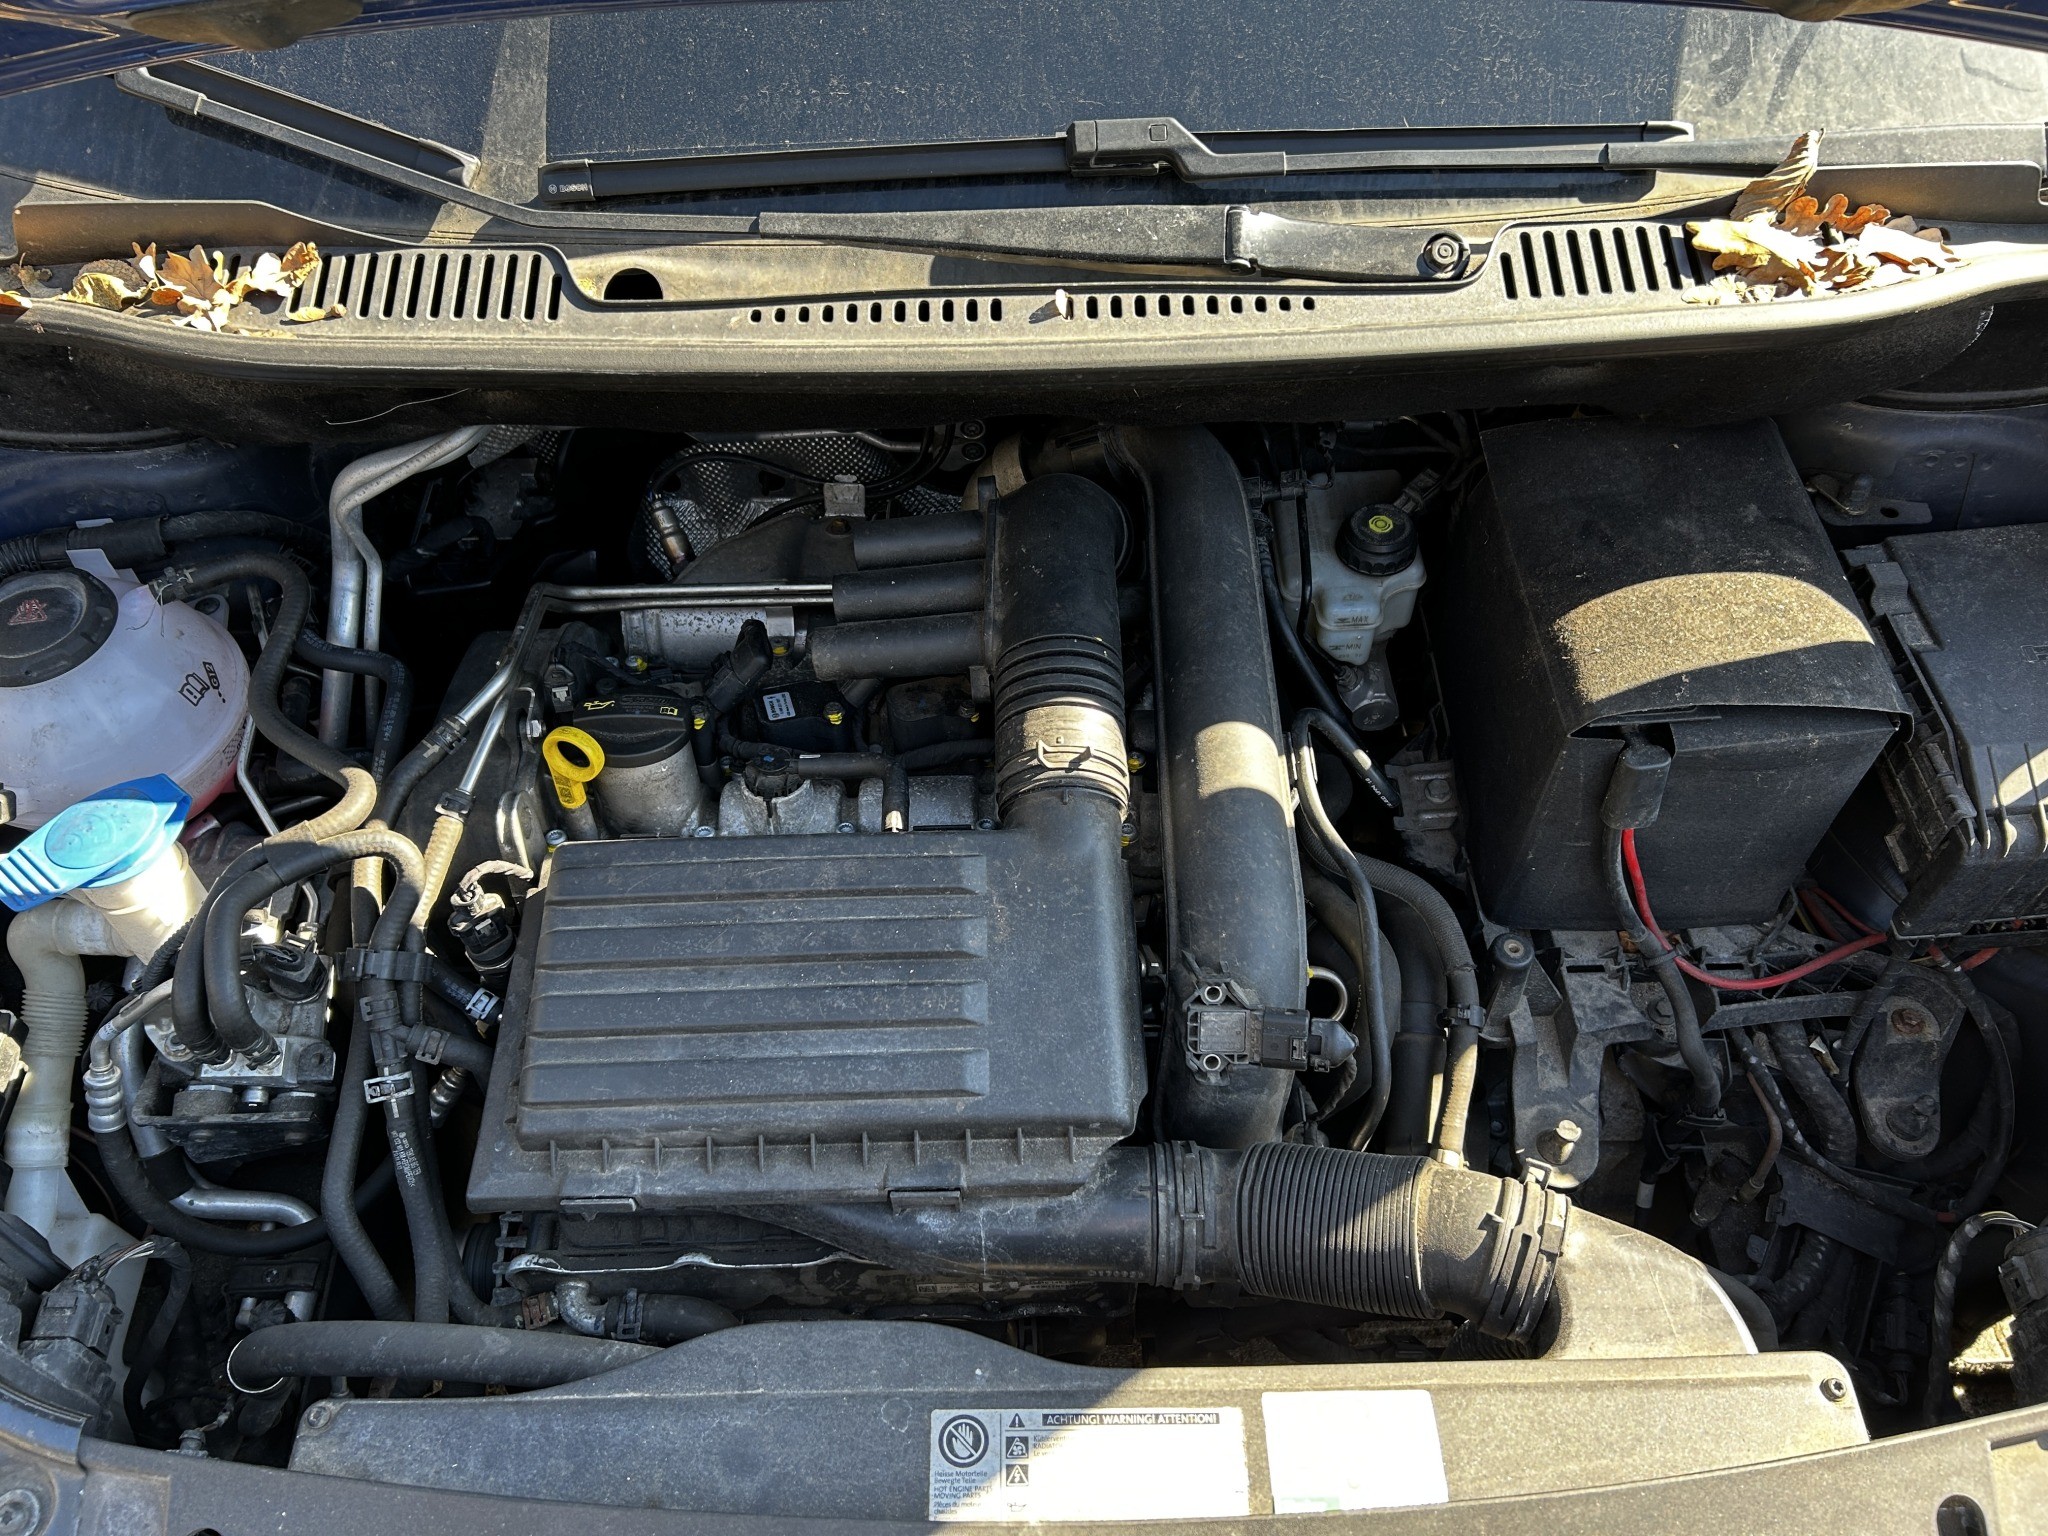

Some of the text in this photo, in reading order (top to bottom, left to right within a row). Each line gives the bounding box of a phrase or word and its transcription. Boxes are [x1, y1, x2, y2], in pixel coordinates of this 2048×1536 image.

[1046, 1413, 1217, 1425] ACHTUNG! WARNING! ATTENTION!
[934, 1477, 961, 1485] Bewegte
